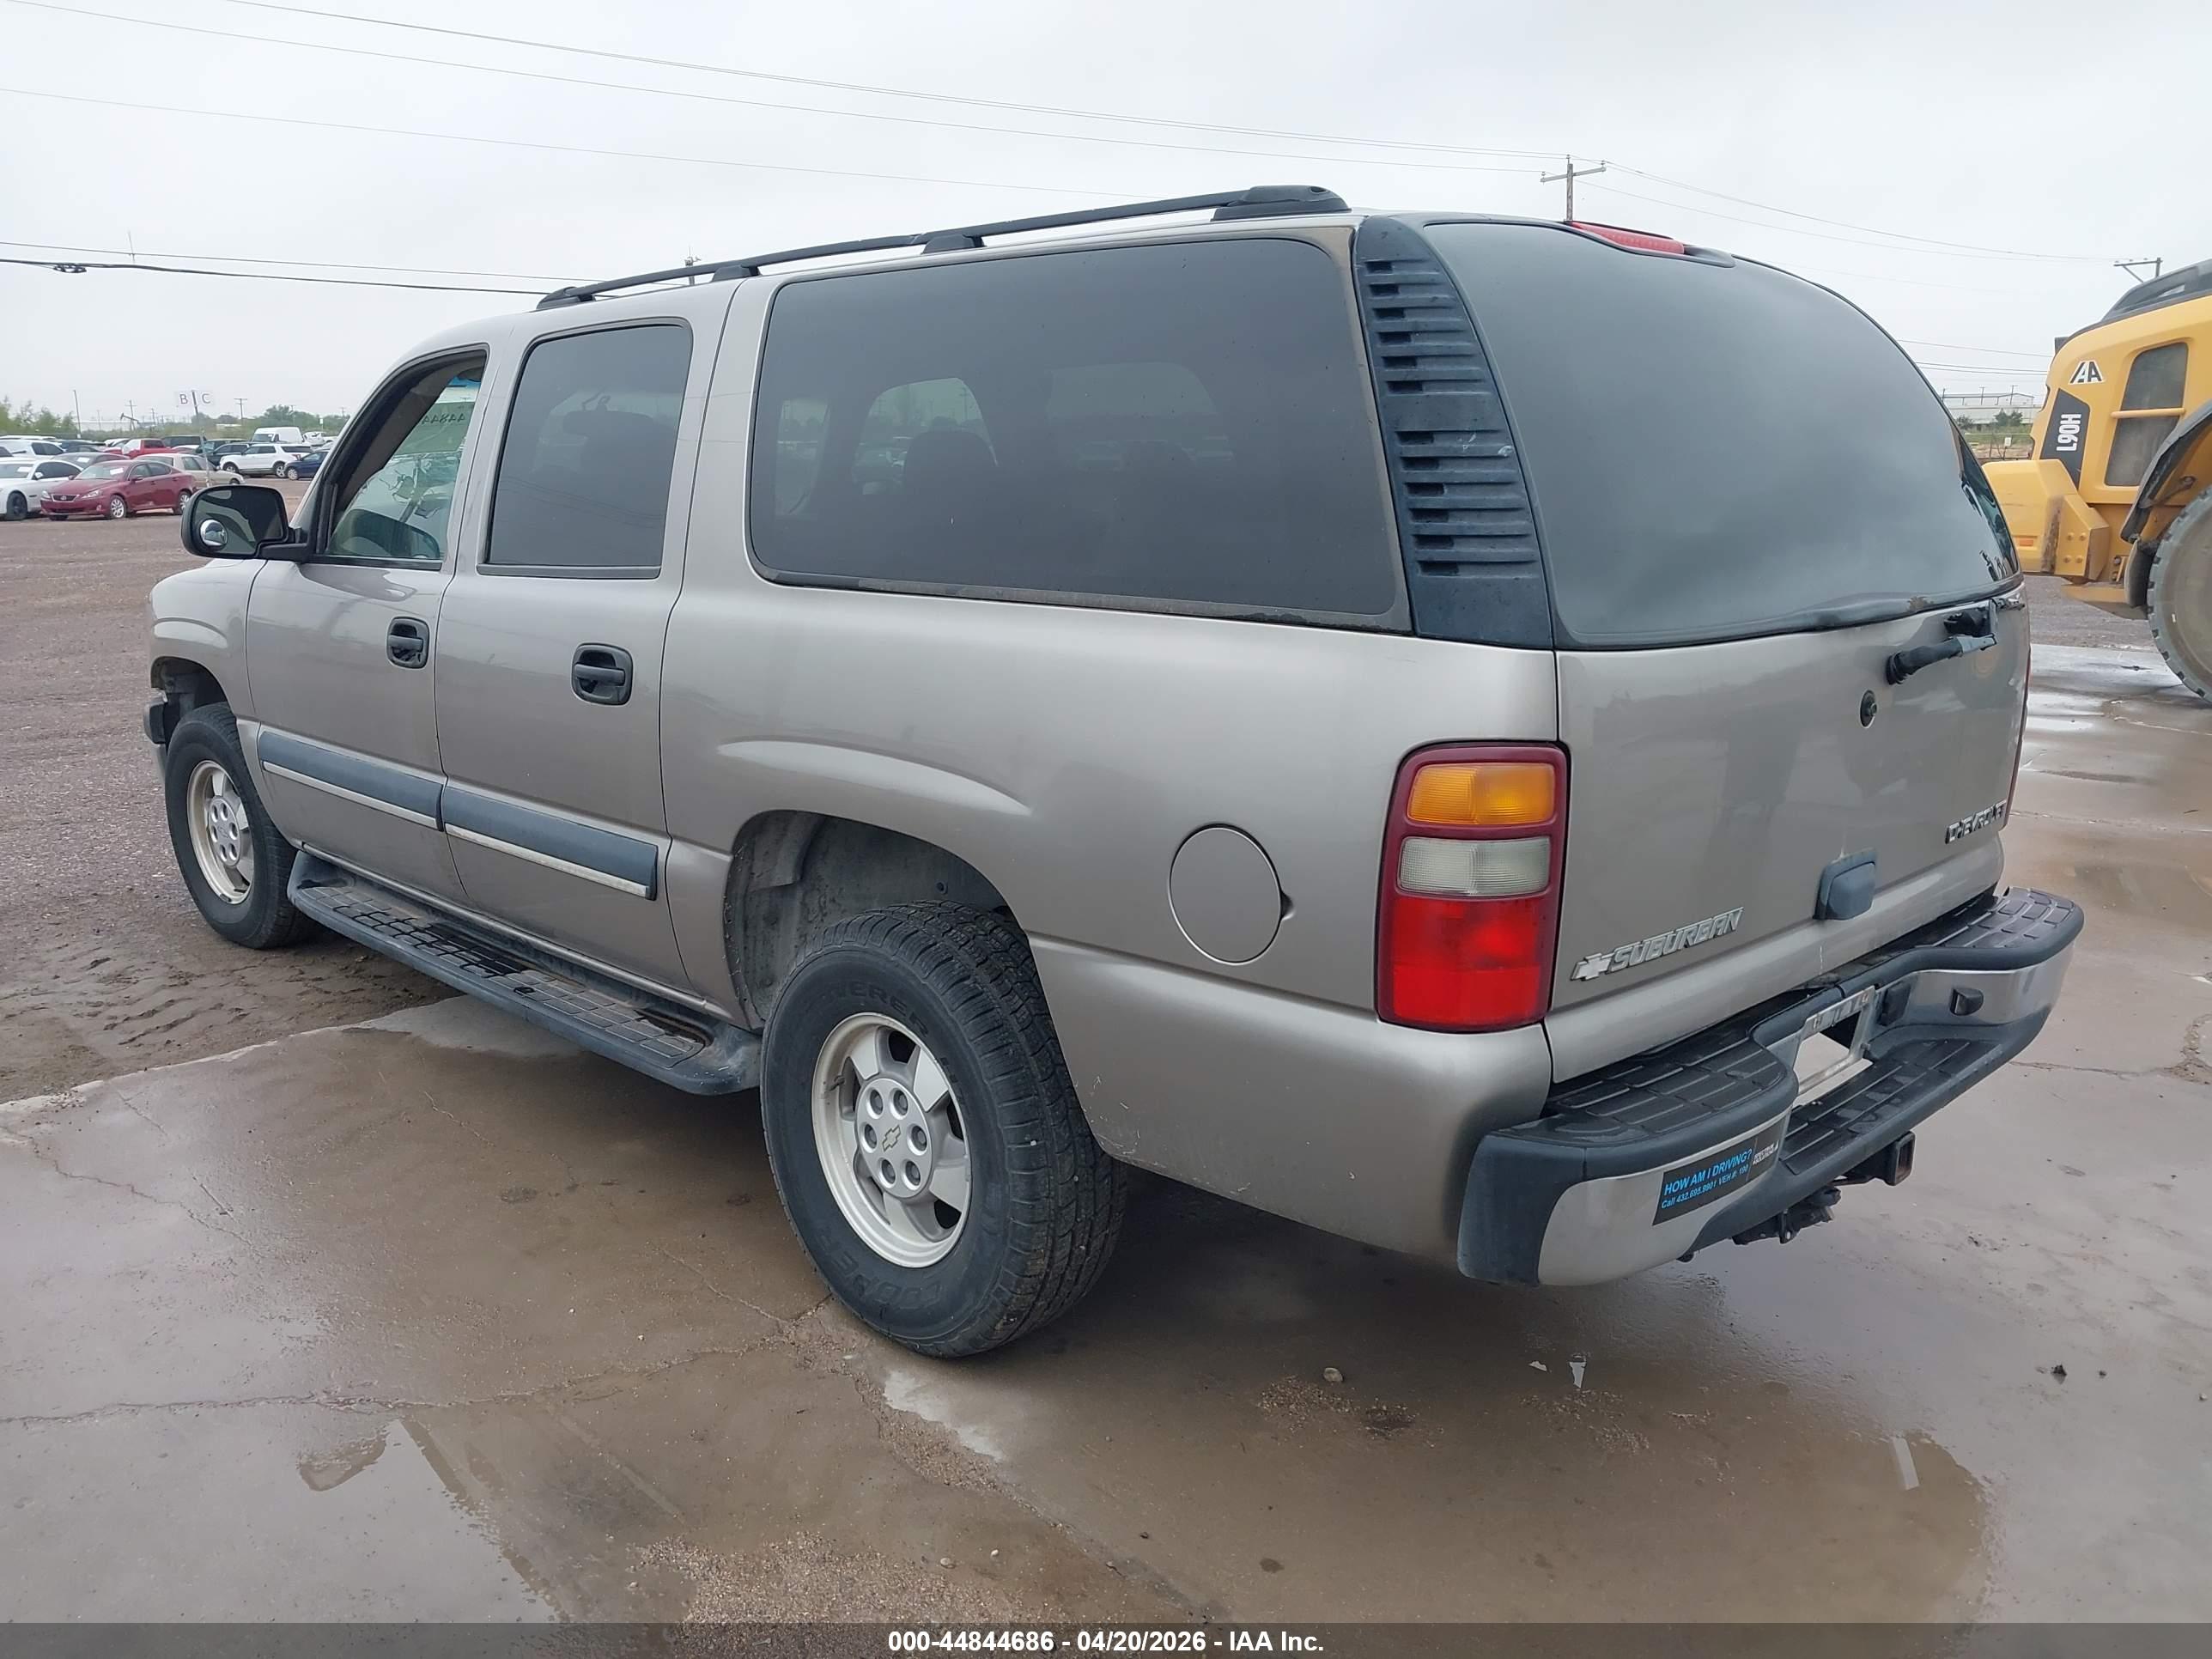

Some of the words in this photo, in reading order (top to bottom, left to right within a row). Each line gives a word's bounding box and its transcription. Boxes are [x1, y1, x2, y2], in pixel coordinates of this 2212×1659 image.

[179, 393, 188, 404] B
[202, 393, 211, 404] C
[2056, 414, 2081, 452] L90H
[1608, 907, 1744, 972] SUBURBAN
[1663, 1177, 1689, 1196] HOW
[1690, 1170, 1706, 1187] AM
[1712, 1148, 1753, 1176] DRIVING?
[1662, 1196, 1675, 1209] Call
